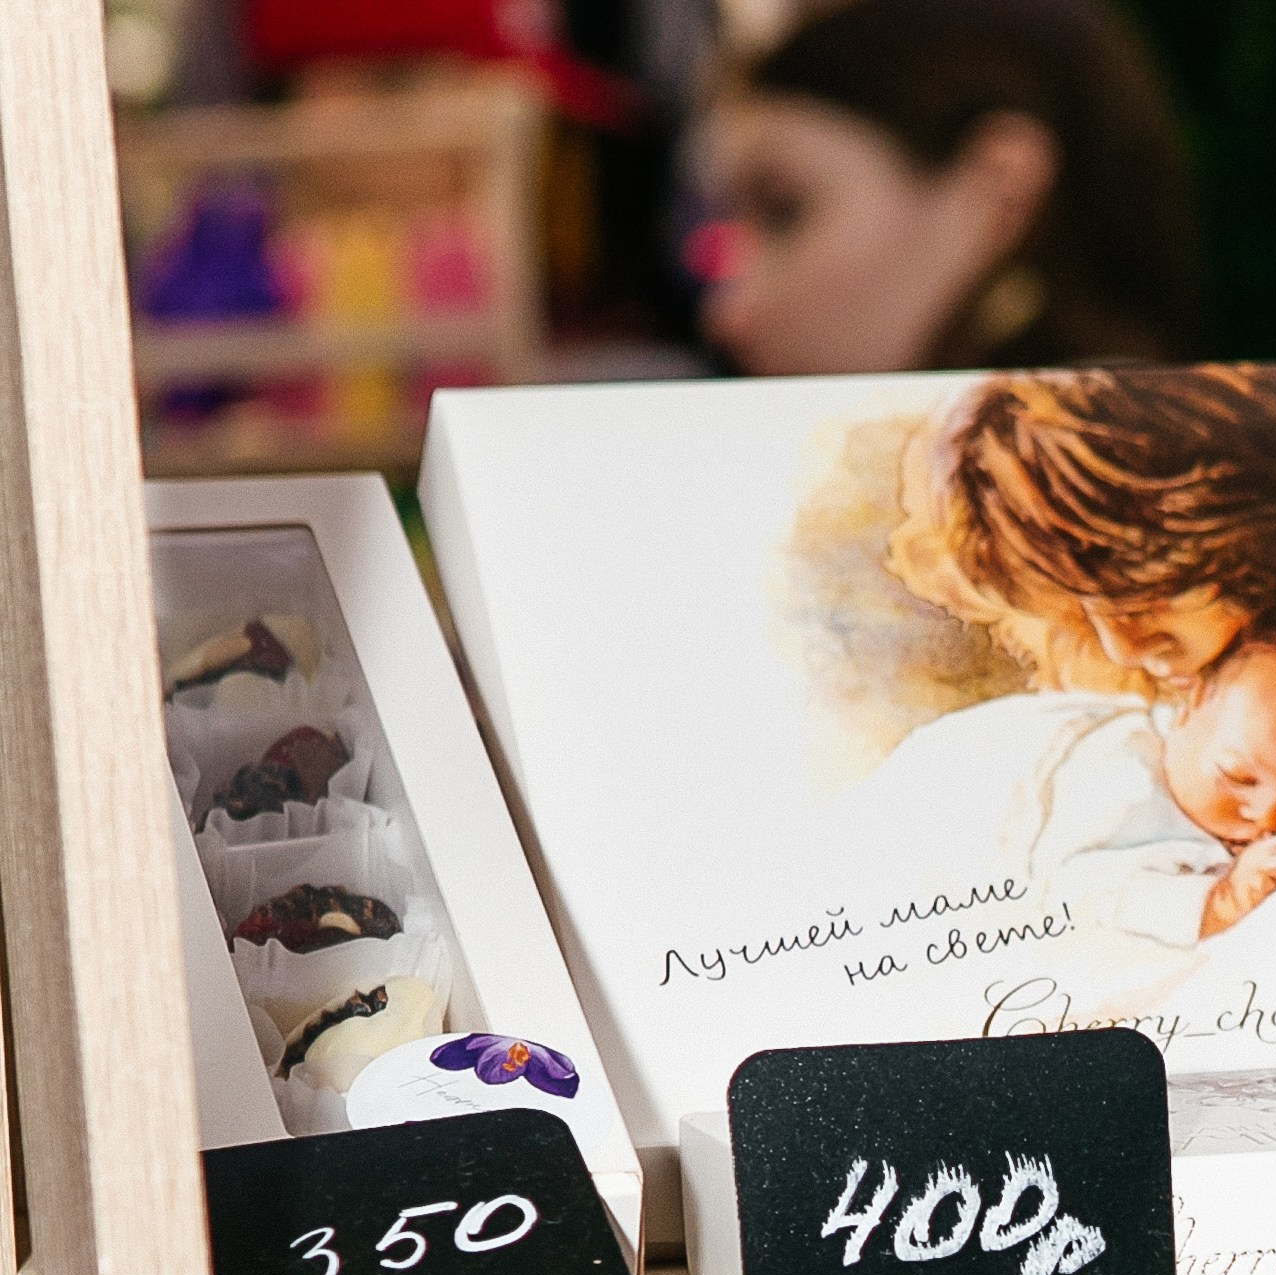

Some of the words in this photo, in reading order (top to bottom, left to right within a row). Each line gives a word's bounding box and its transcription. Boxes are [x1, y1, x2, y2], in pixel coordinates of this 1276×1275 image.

[660, 906, 863, 986] Лучшей
[880, 878, 1028, 928] маме
[843, 954, 908, 986] на
[926, 902, 1076, 965] свете!
